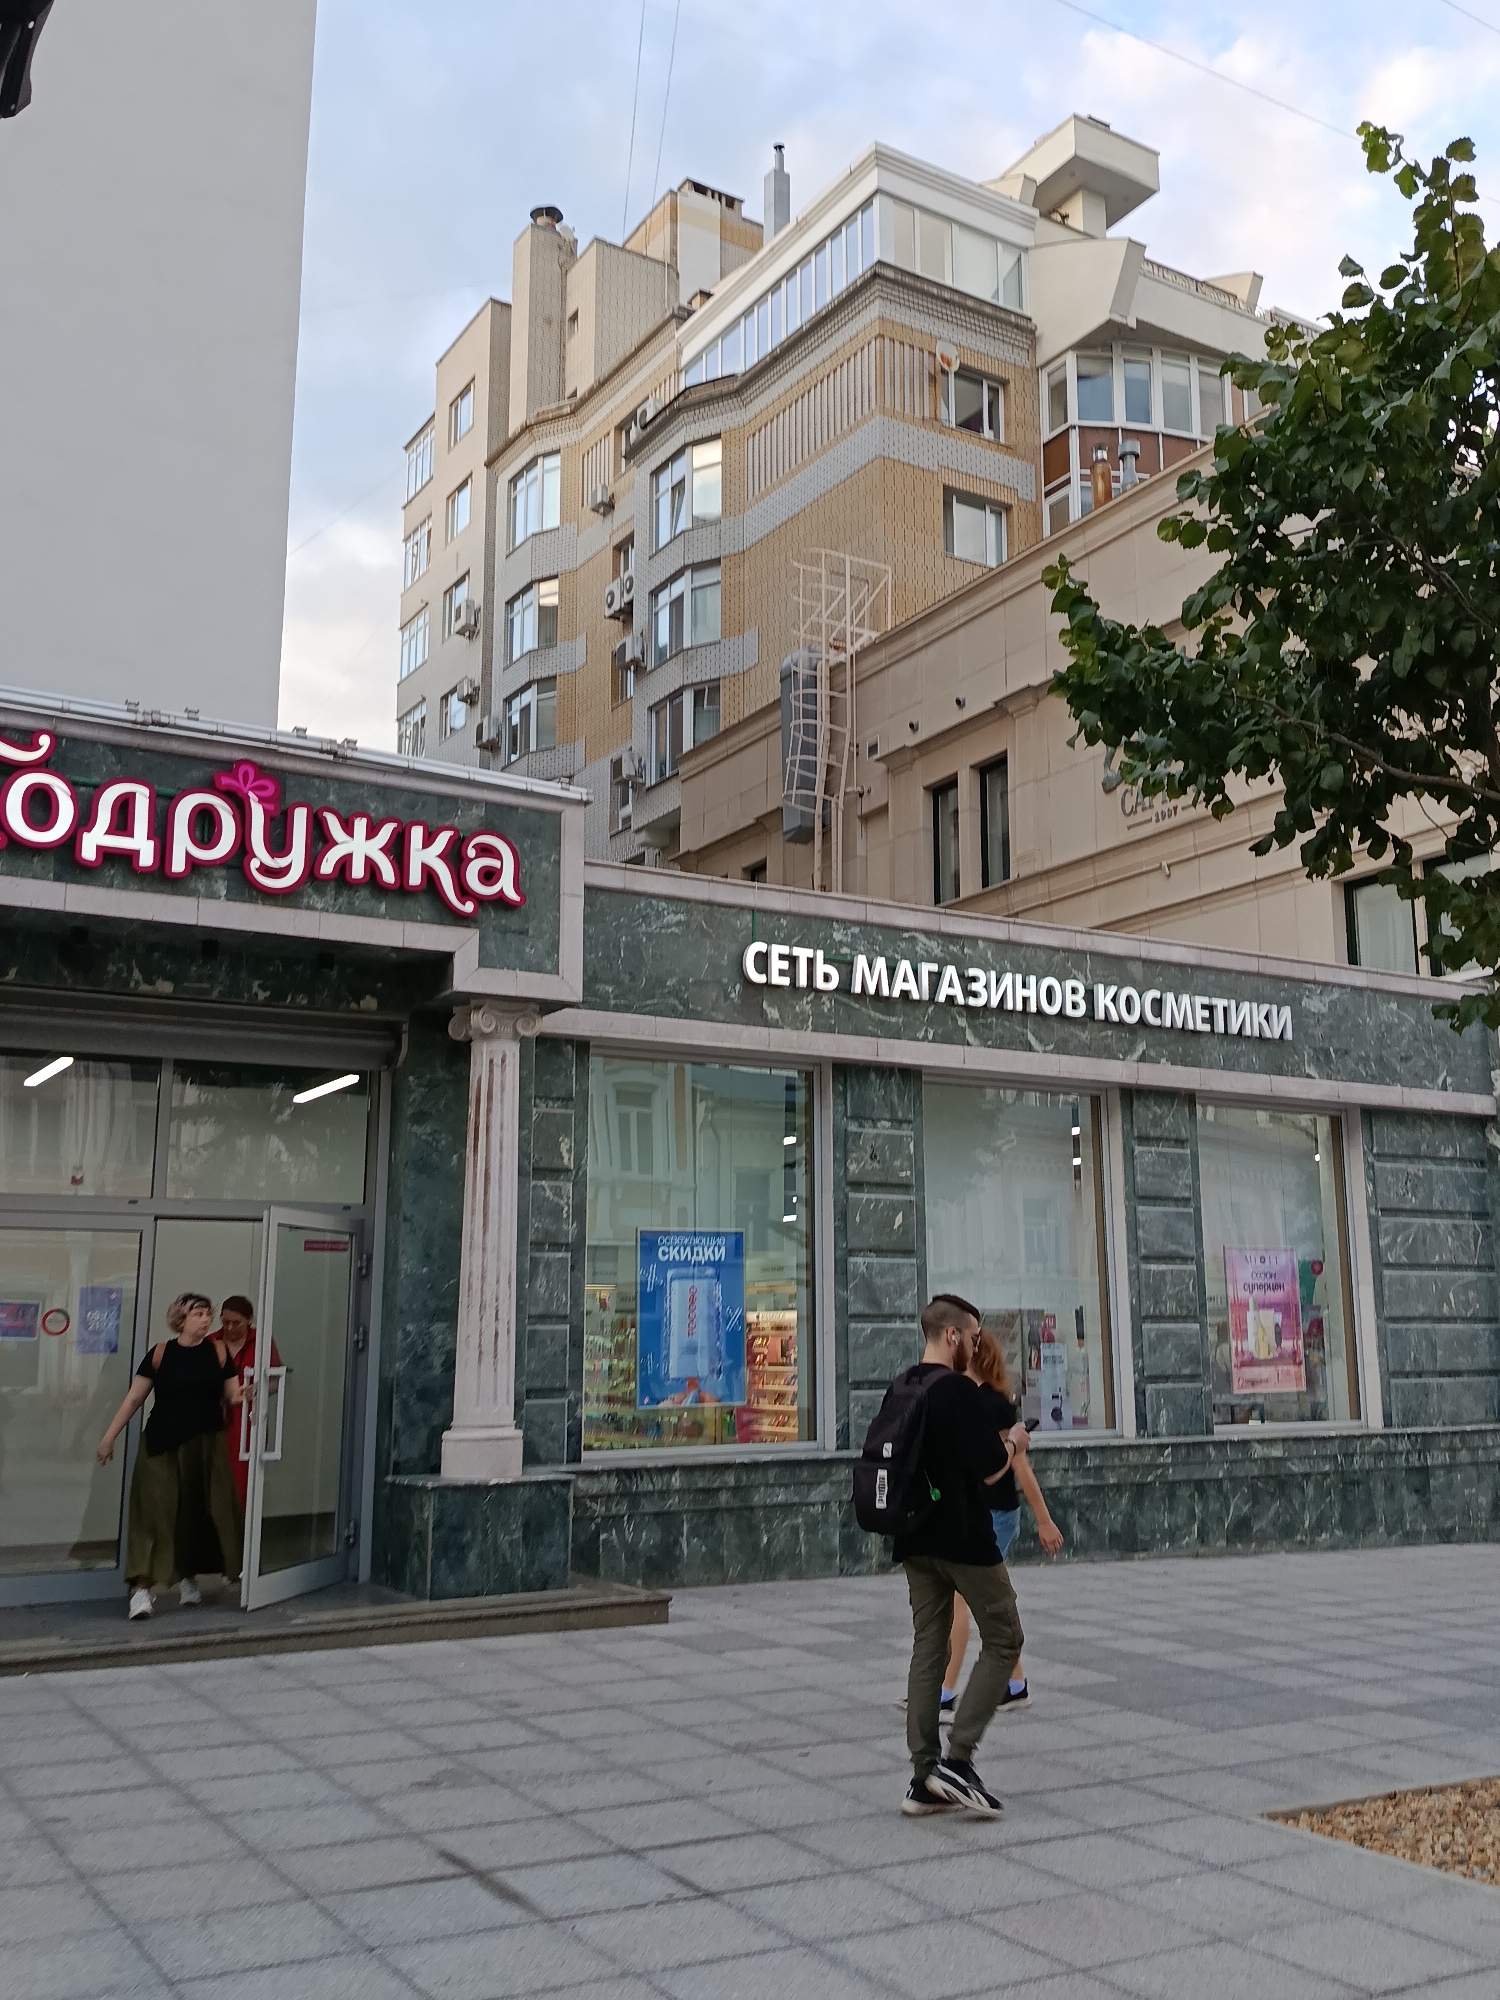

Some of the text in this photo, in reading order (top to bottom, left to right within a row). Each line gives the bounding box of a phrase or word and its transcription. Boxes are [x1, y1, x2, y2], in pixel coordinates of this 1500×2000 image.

[0, 731, 525, 916] одружка
[743, 940, 1293, 1041] СЕТЬ МАГАЗИНОВ КОСМЕТИКИ
[657, 1245, 726, 1266] СКИДКИ
